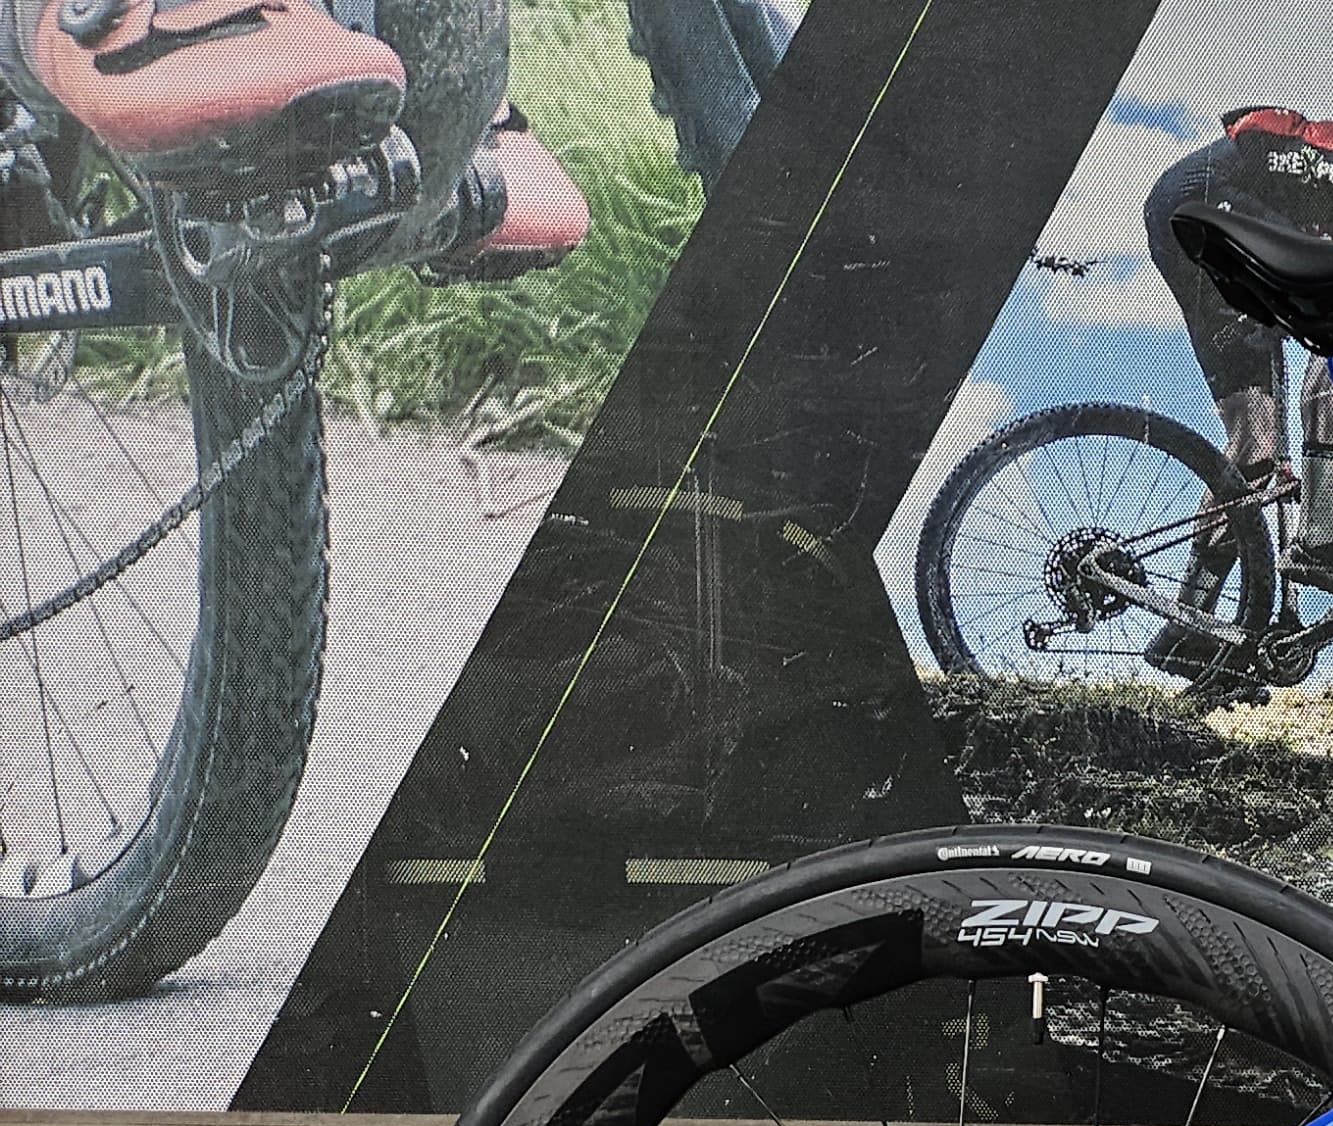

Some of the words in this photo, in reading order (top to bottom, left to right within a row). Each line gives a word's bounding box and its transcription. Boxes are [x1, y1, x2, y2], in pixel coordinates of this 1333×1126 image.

[0, 266, 112, 320] MANO
[1011, 845, 1112, 866] AERO
[960, 900, 1160, 935] ZIPP
